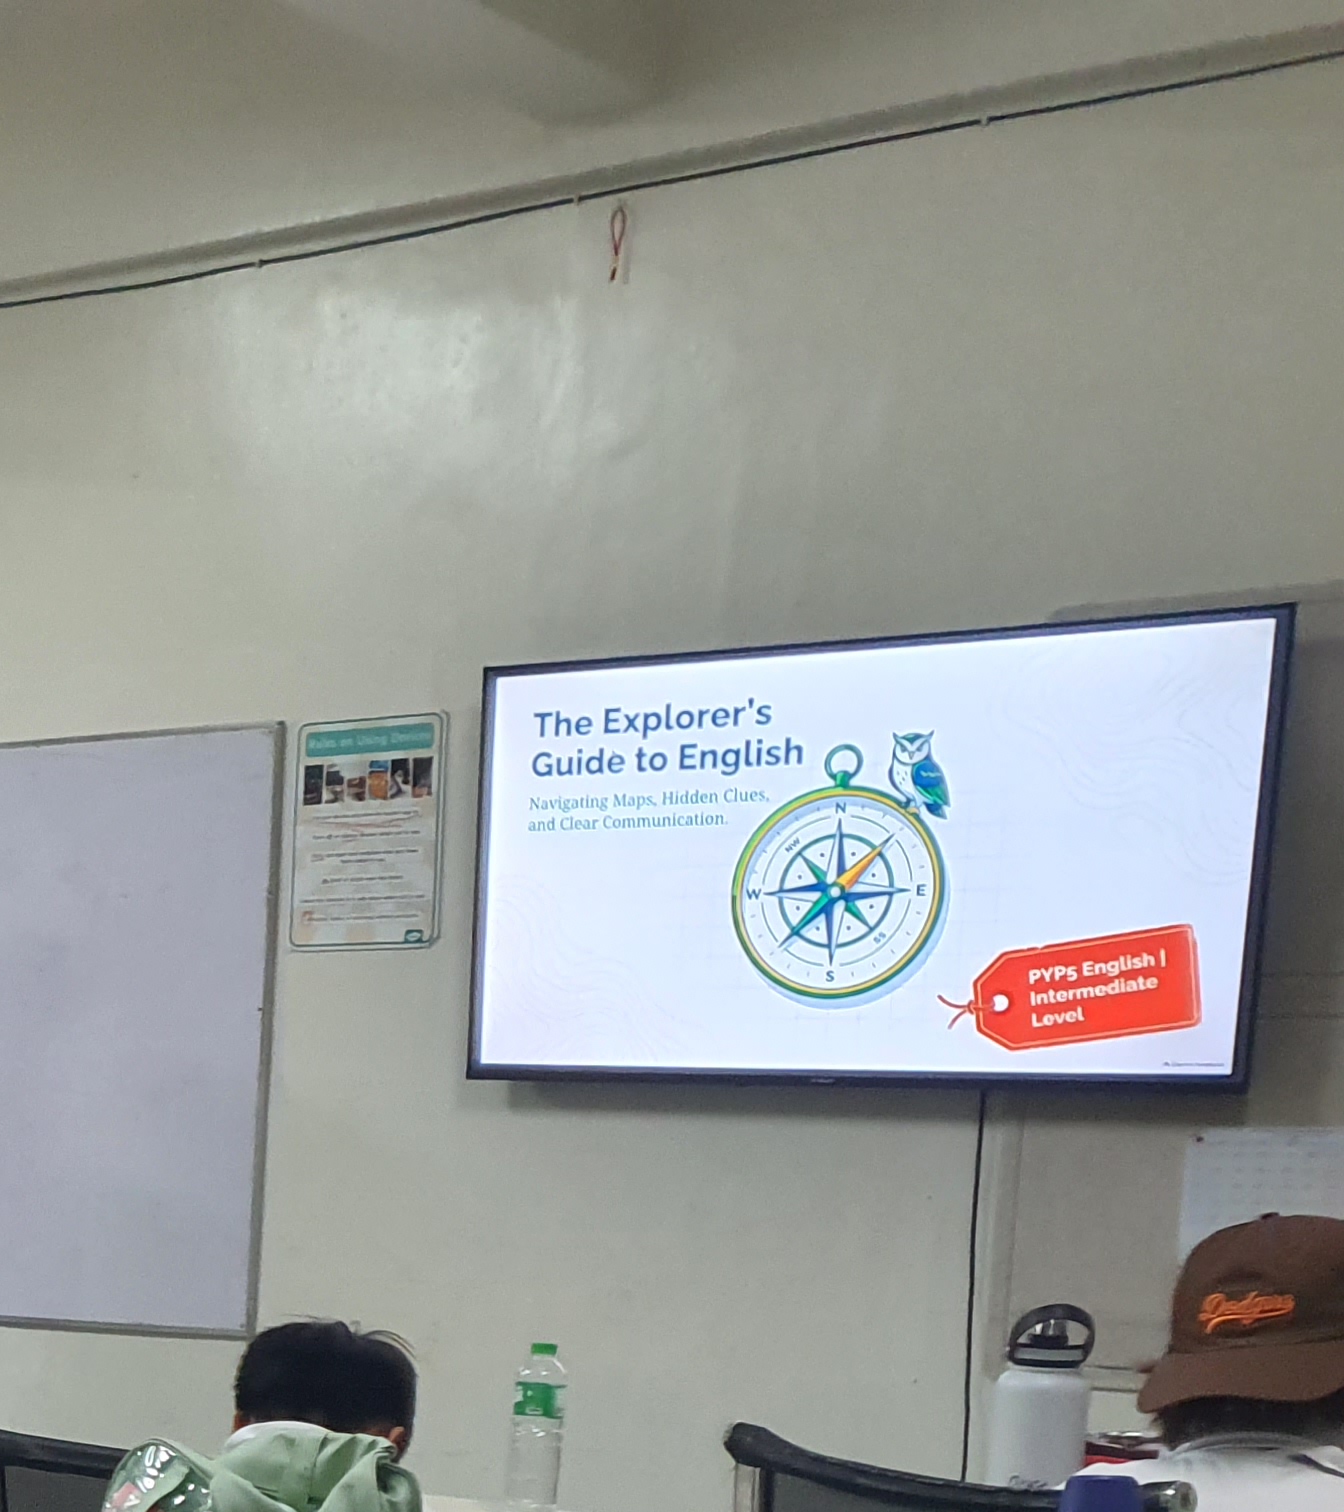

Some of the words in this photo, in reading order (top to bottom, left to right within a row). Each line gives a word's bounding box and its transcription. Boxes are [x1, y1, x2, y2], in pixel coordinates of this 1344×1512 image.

[534, 711, 593, 737] The
[603, 698, 772, 739] Explorer's
[531, 748, 626, 777] Guide
[635, 747, 668, 772] to
[679, 737, 803, 776] English
[529, 796, 609, 814] Navigating
[612, 793, 657, 811] Maps,
[662, 789, 719, 806] Hidden
[723, 788, 770, 803] Clues,
[835, 802, 846, 814] N
[528, 817, 556, 832] and
[559, 816, 598, 831] Clear
[602, 812, 728, 830] Communication.
[784, 837, 801, 853] NW
[746, 887, 762, 900] W
[916, 884, 927, 897] E
[825, 970, 835, 983] S
[1029, 967, 1078, 984] PYP5
[1082, 953, 1155, 977] English
[1030, 975, 1159, 1006] Intermediate
[1031, 1005, 1085, 1028] Level
